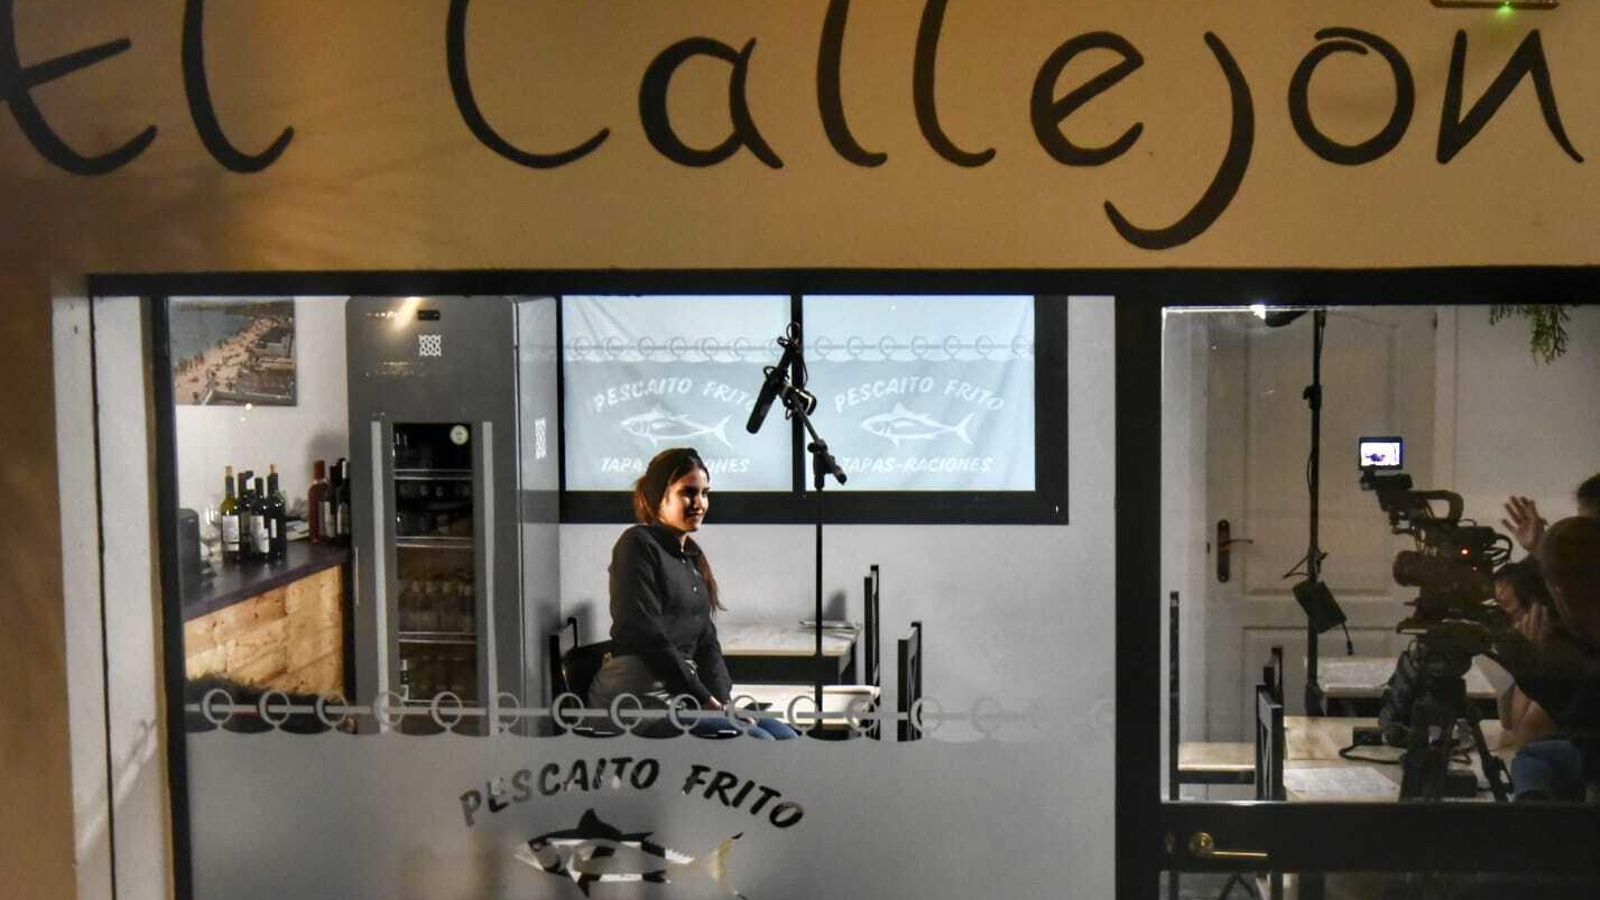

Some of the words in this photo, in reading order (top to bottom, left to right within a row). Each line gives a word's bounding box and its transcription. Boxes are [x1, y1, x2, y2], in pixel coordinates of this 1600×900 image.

[0, 0, 294, 176] El
[592, 377, 694, 414] PESCAITO
[833, 376, 935, 414] PESCAITO
[943, 378, 1005, 411] FRITO
[842, 456, 993, 473] TAPAS-RACIONES
[458, 756, 661, 828] PESCAITO
[681, 763, 804, 830] FRITO
